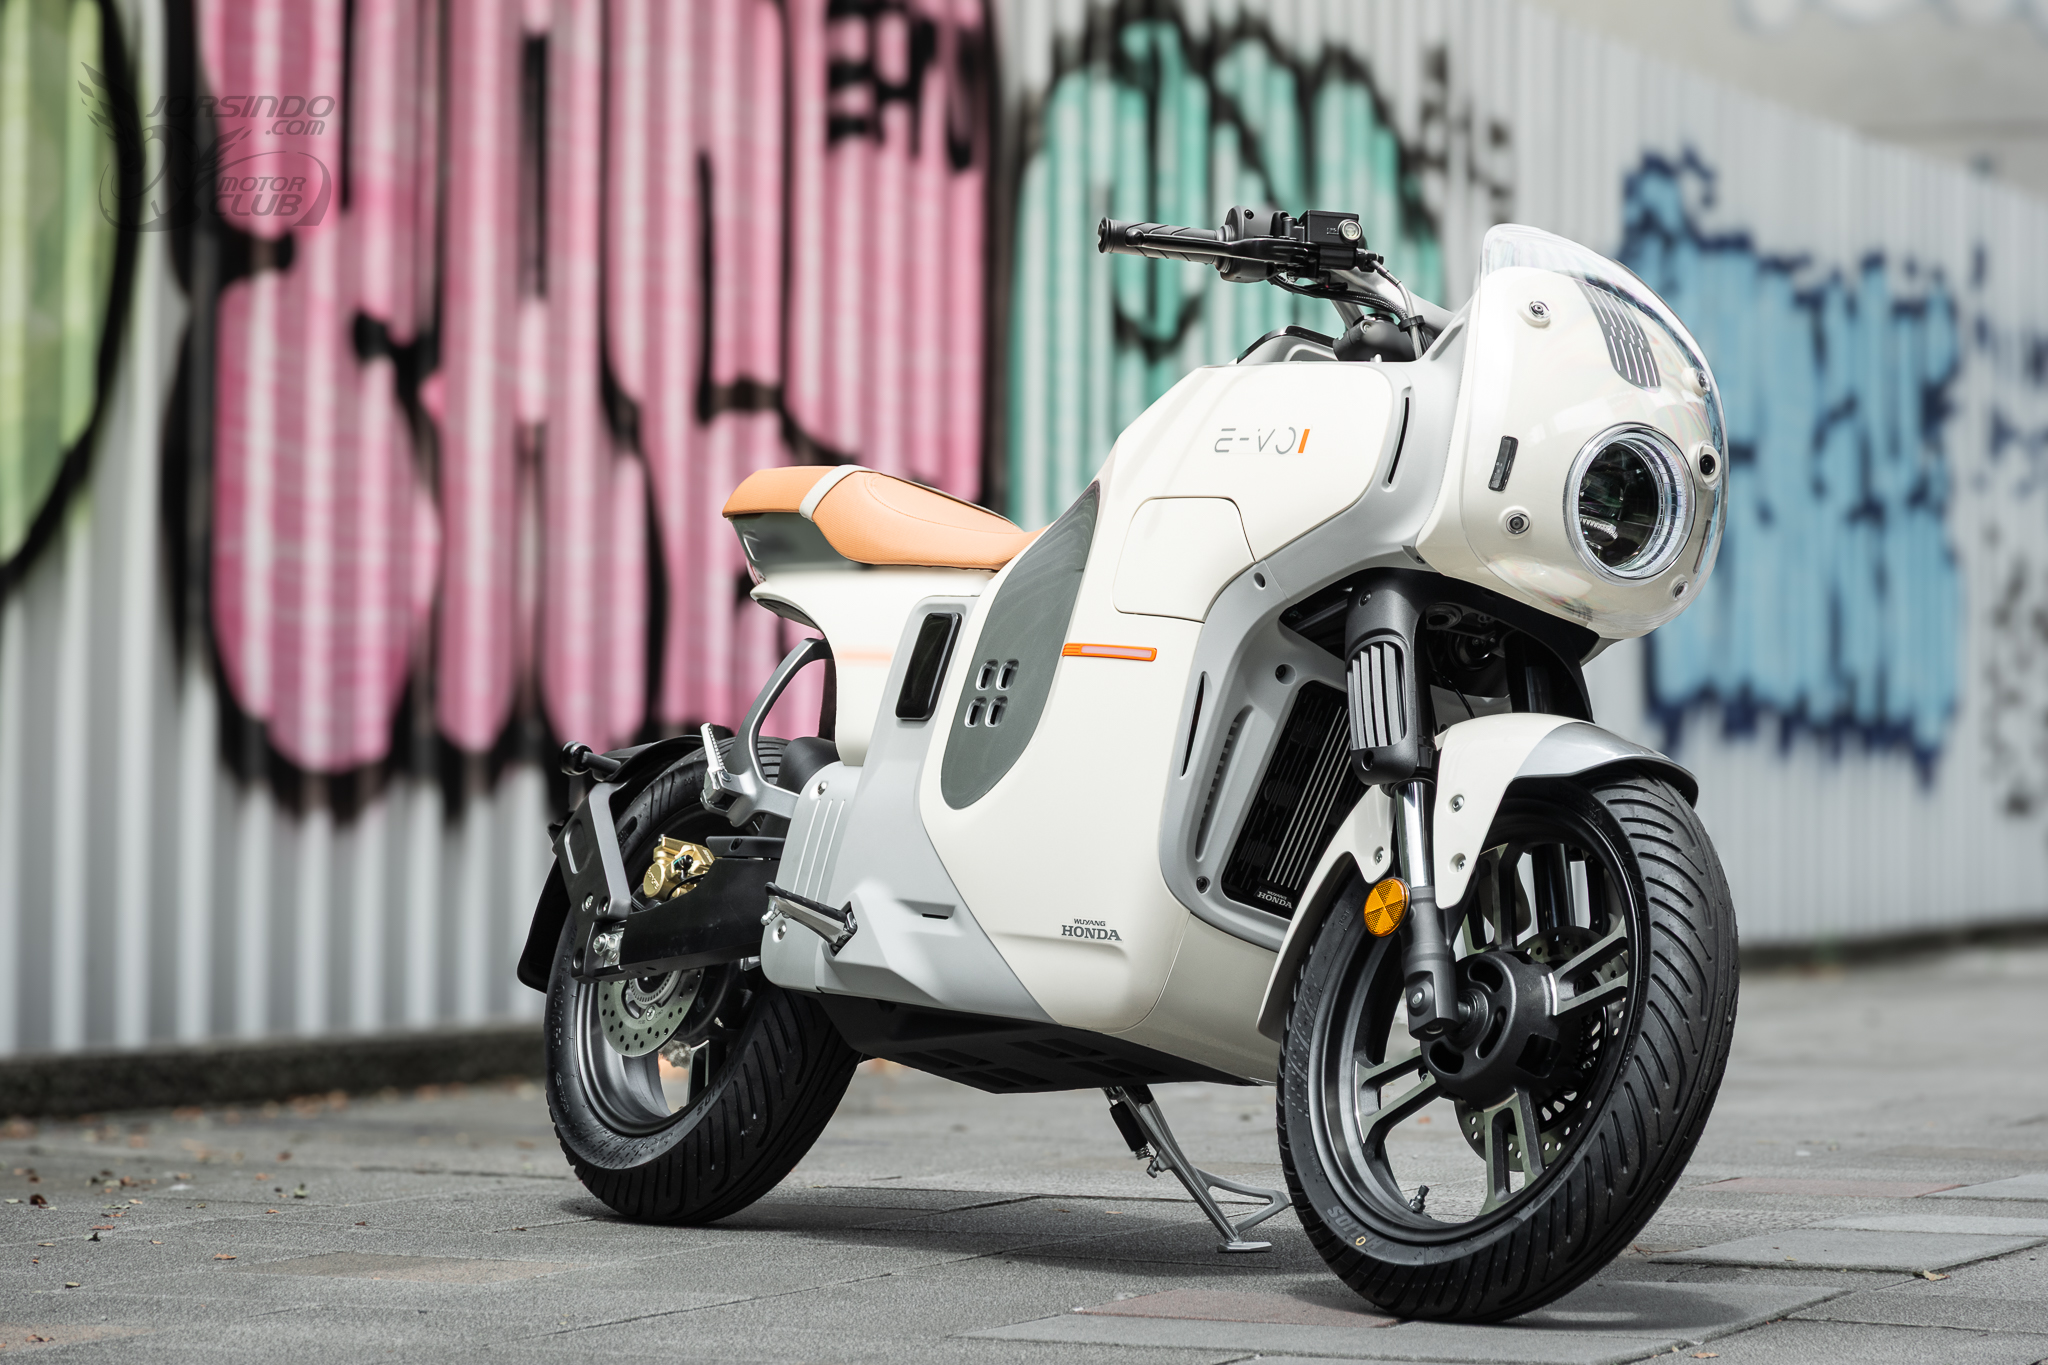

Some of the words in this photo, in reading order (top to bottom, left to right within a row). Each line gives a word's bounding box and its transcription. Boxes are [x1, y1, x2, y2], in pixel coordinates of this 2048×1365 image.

[1256, 891, 1293, 909] HONDA
[1073, 918, 1106, 927] WUYANG
[1061, 924, 1123, 941] HONDA
